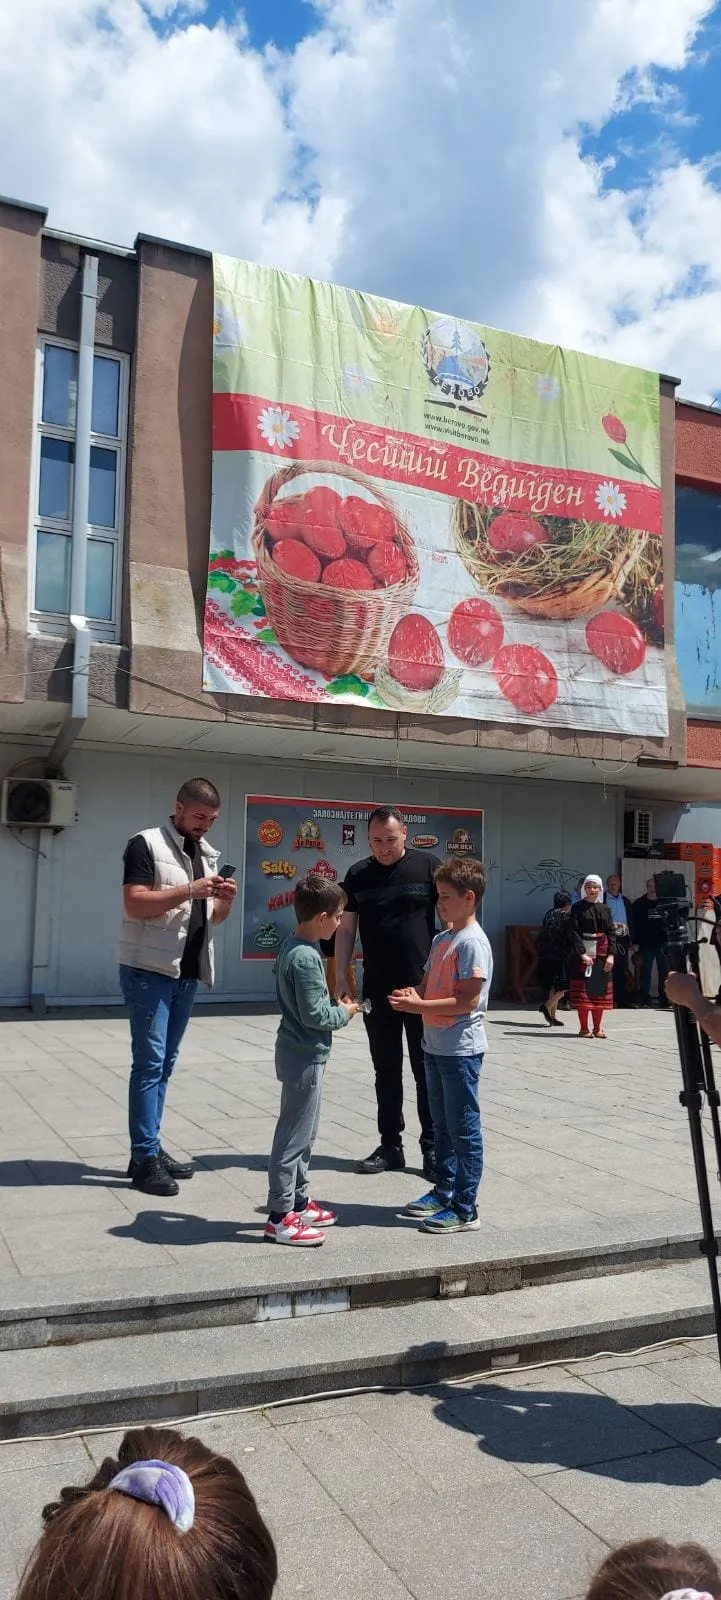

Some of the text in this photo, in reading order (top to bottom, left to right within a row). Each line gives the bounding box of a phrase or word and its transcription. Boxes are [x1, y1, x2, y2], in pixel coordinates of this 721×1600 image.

[432, 376, 481, 398] БЕРОВО
[423, 412, 490, 436] www.berovo.gov.mk
[424, 422, 490, 446] www.visitberovo.mk
[260, 860, 298, 879] Salty
